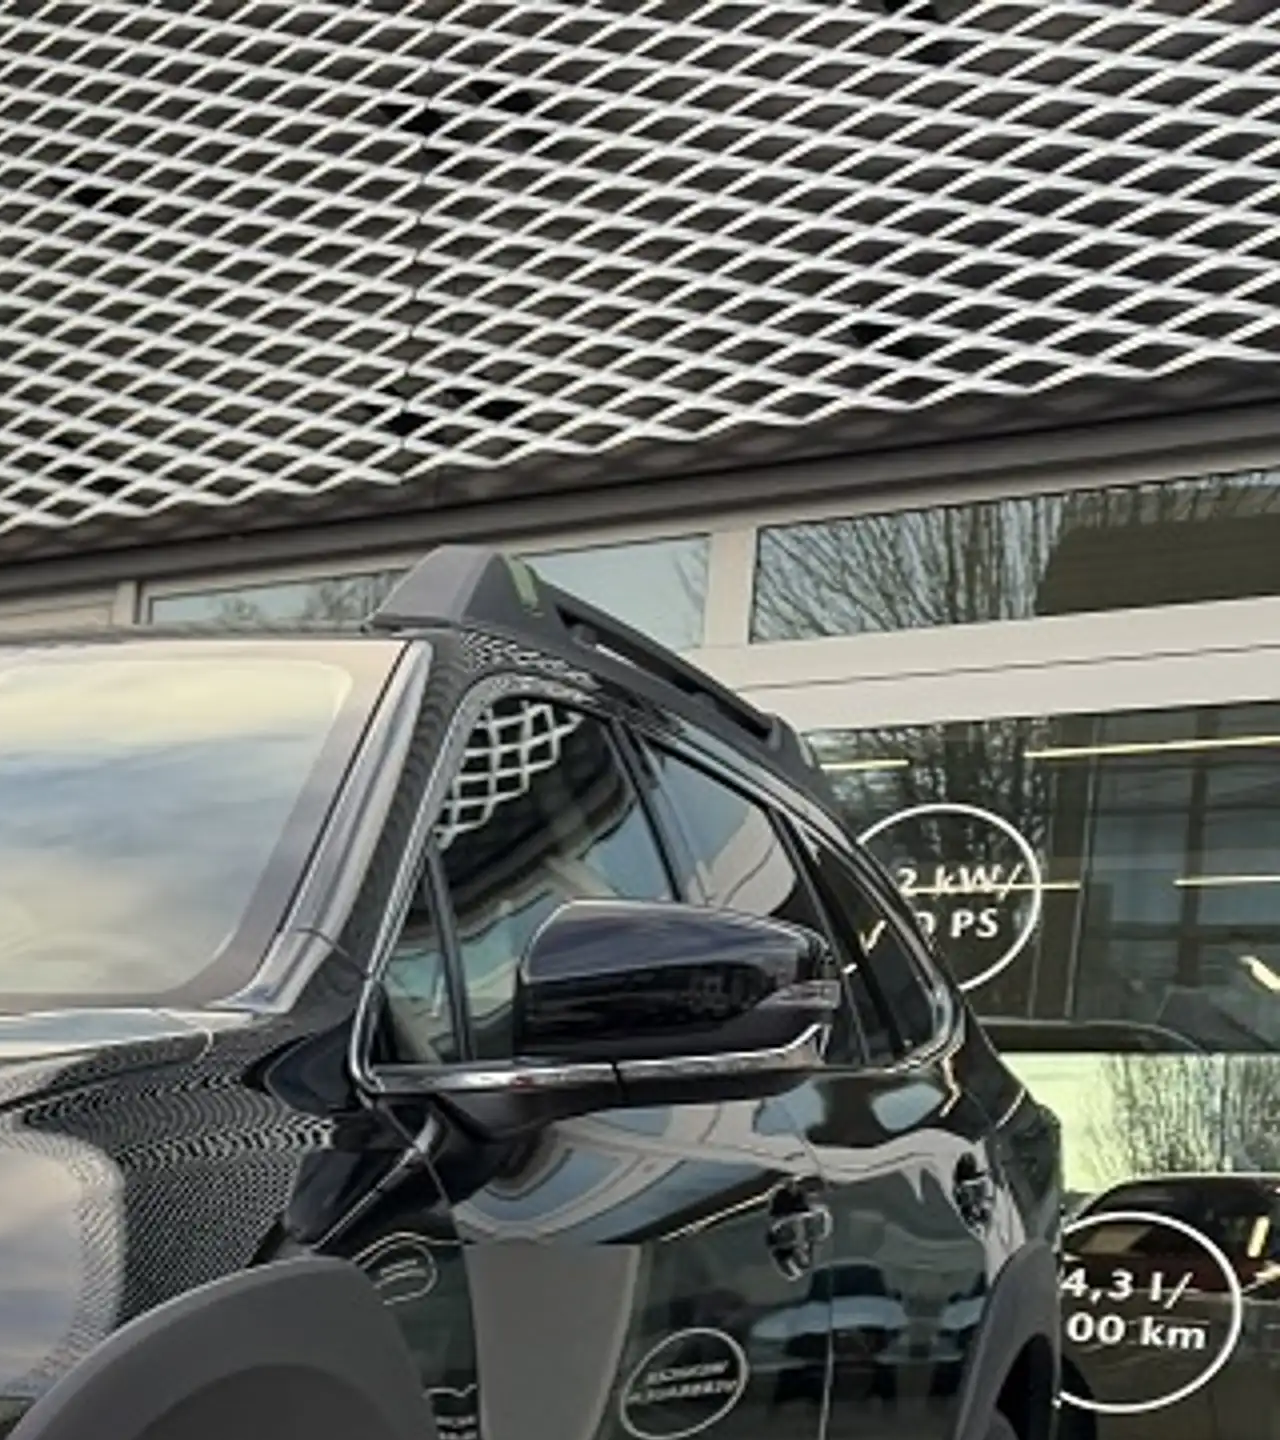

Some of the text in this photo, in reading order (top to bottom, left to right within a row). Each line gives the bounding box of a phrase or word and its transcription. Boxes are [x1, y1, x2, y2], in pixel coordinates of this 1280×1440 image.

[950, 908, 998, 938] PS
[1060, 1267, 1134, 1304] 4,3
[1141, 1315, 1206, 1349] km
